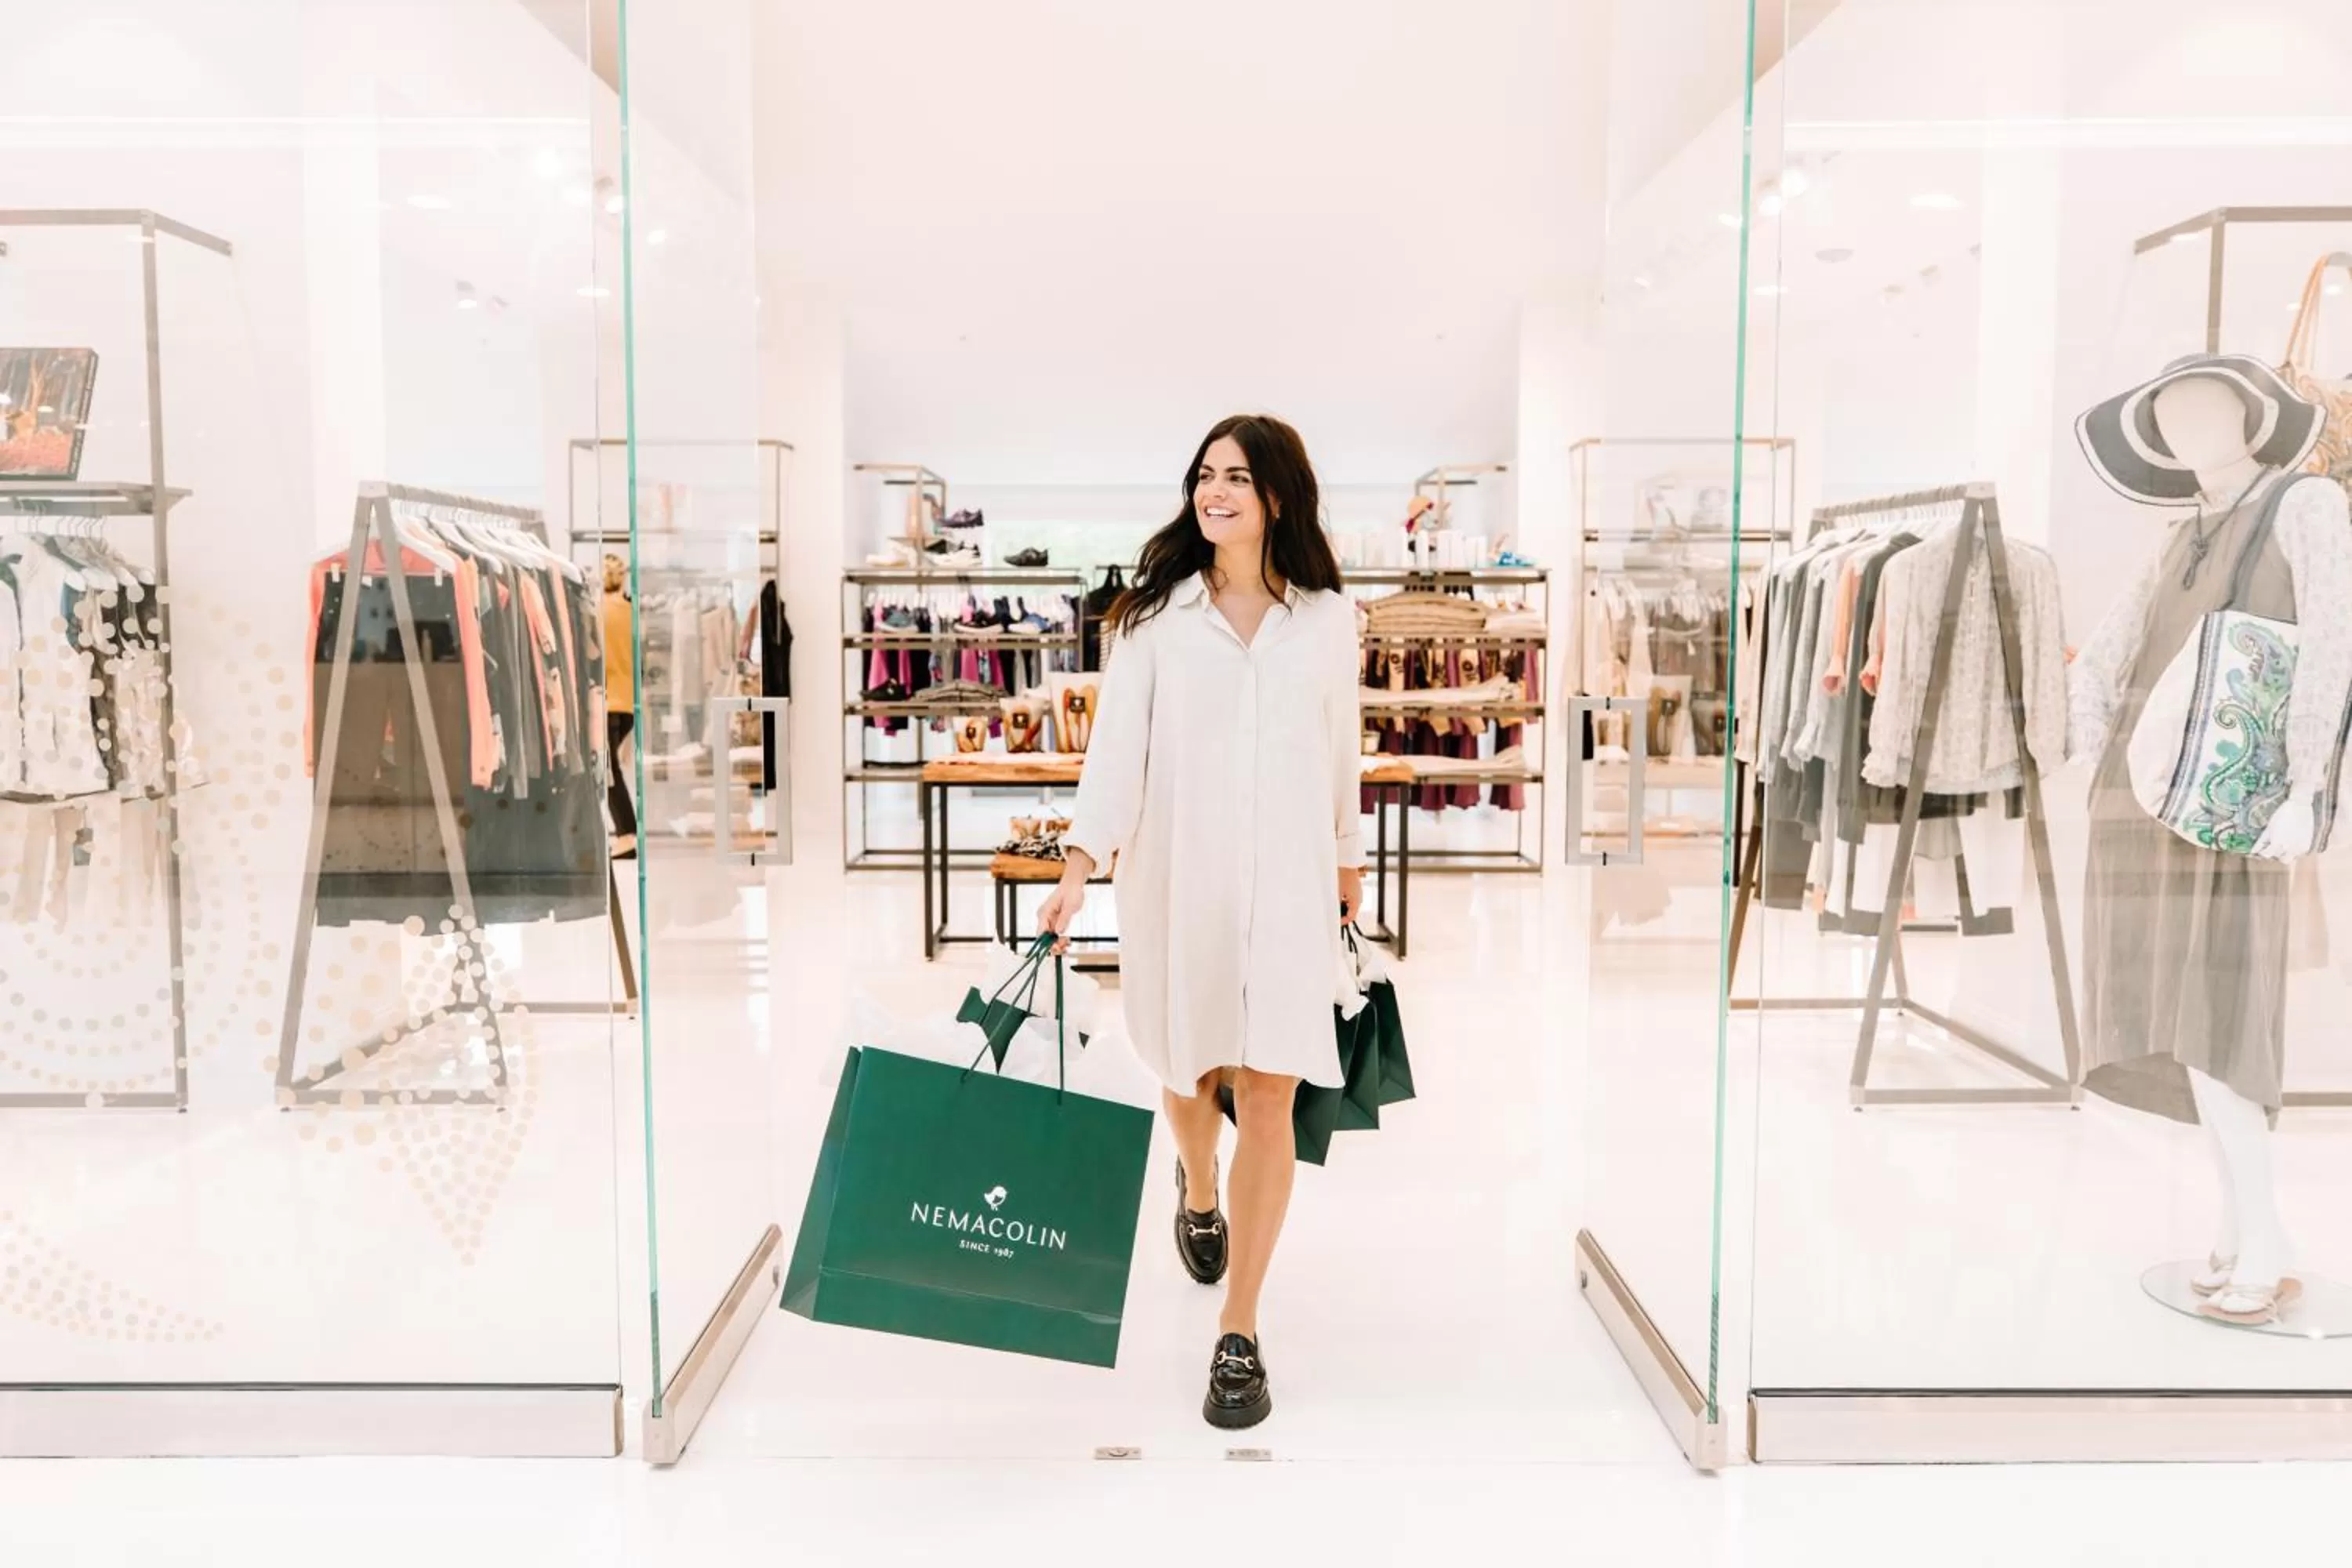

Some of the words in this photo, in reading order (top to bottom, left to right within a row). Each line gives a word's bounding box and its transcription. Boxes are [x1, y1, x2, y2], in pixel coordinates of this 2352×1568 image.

[910, 1201, 1066, 1250] NEMACOLIN
[959, 1240, 989, 1253] SINCE
[993, 1247, 1014, 1259] 1987
